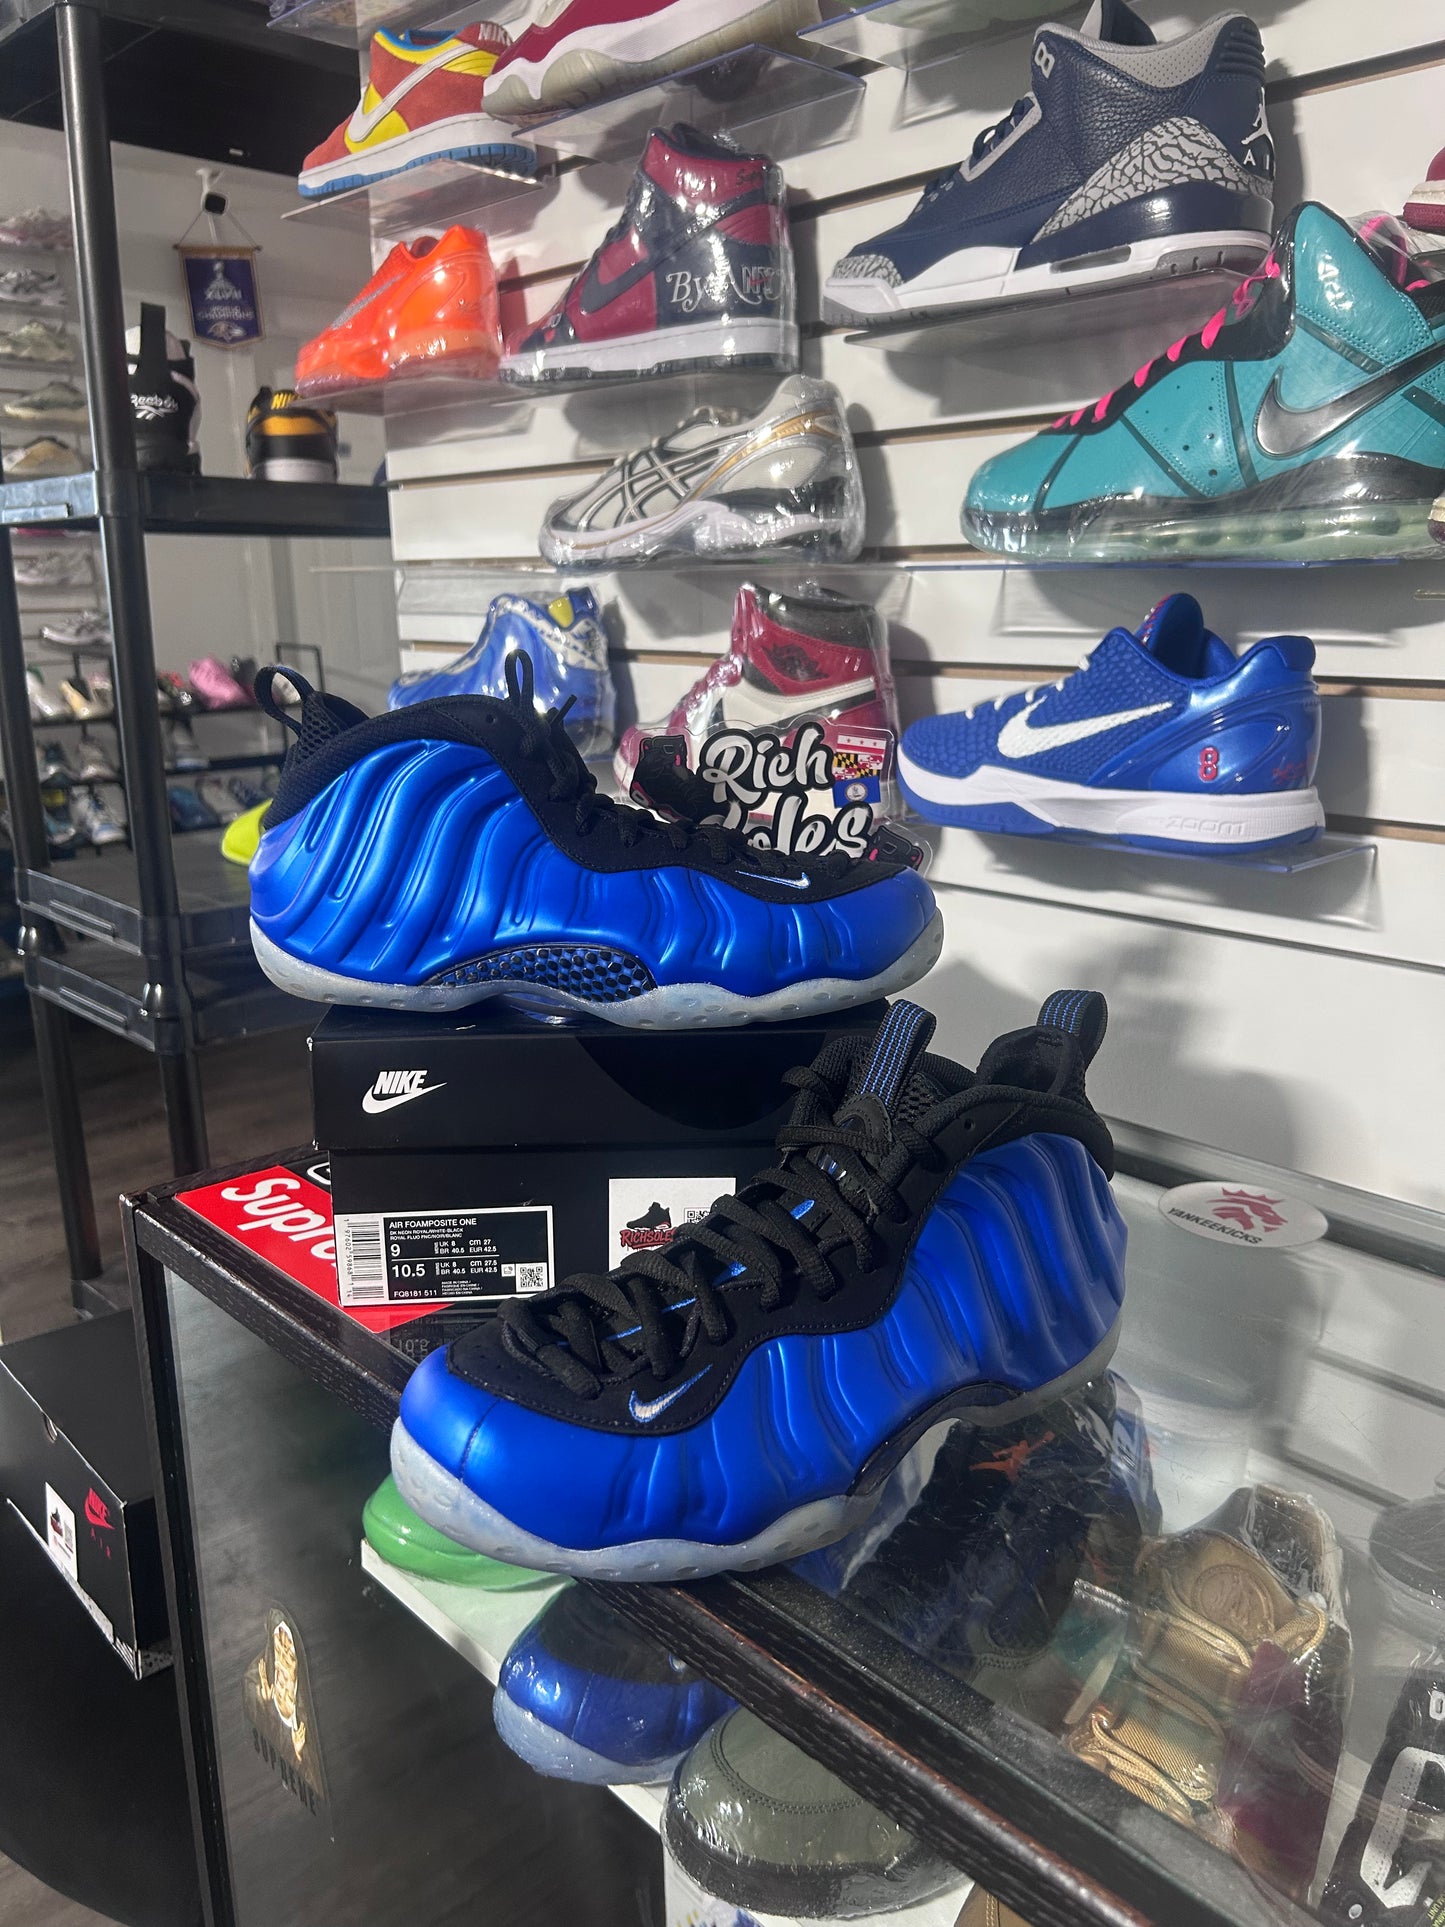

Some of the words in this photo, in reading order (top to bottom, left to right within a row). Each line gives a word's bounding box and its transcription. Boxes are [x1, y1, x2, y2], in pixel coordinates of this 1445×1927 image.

[478, 23, 511, 47] NIK
[1242, 149, 1270, 171] AI
[701, 726, 829, 804] Rich
[1198, 745, 1219, 783] 8
[373, 1069, 428, 1096] NIKE
[389, 1221, 404, 1229] AIR
[404, 1219, 458, 1228] FOAMPOSITE
[459, 1218, 477, 1226] ONE
[1167, 1207, 1262, 1245] YANKEEKICKS
[619, 1226, 677, 1249] RICHSOLE
[390, 1243, 401, 1257] 9
[391, 1263, 426, 1278] 10.5
[393, 1290, 422, 1298] FQ8181
